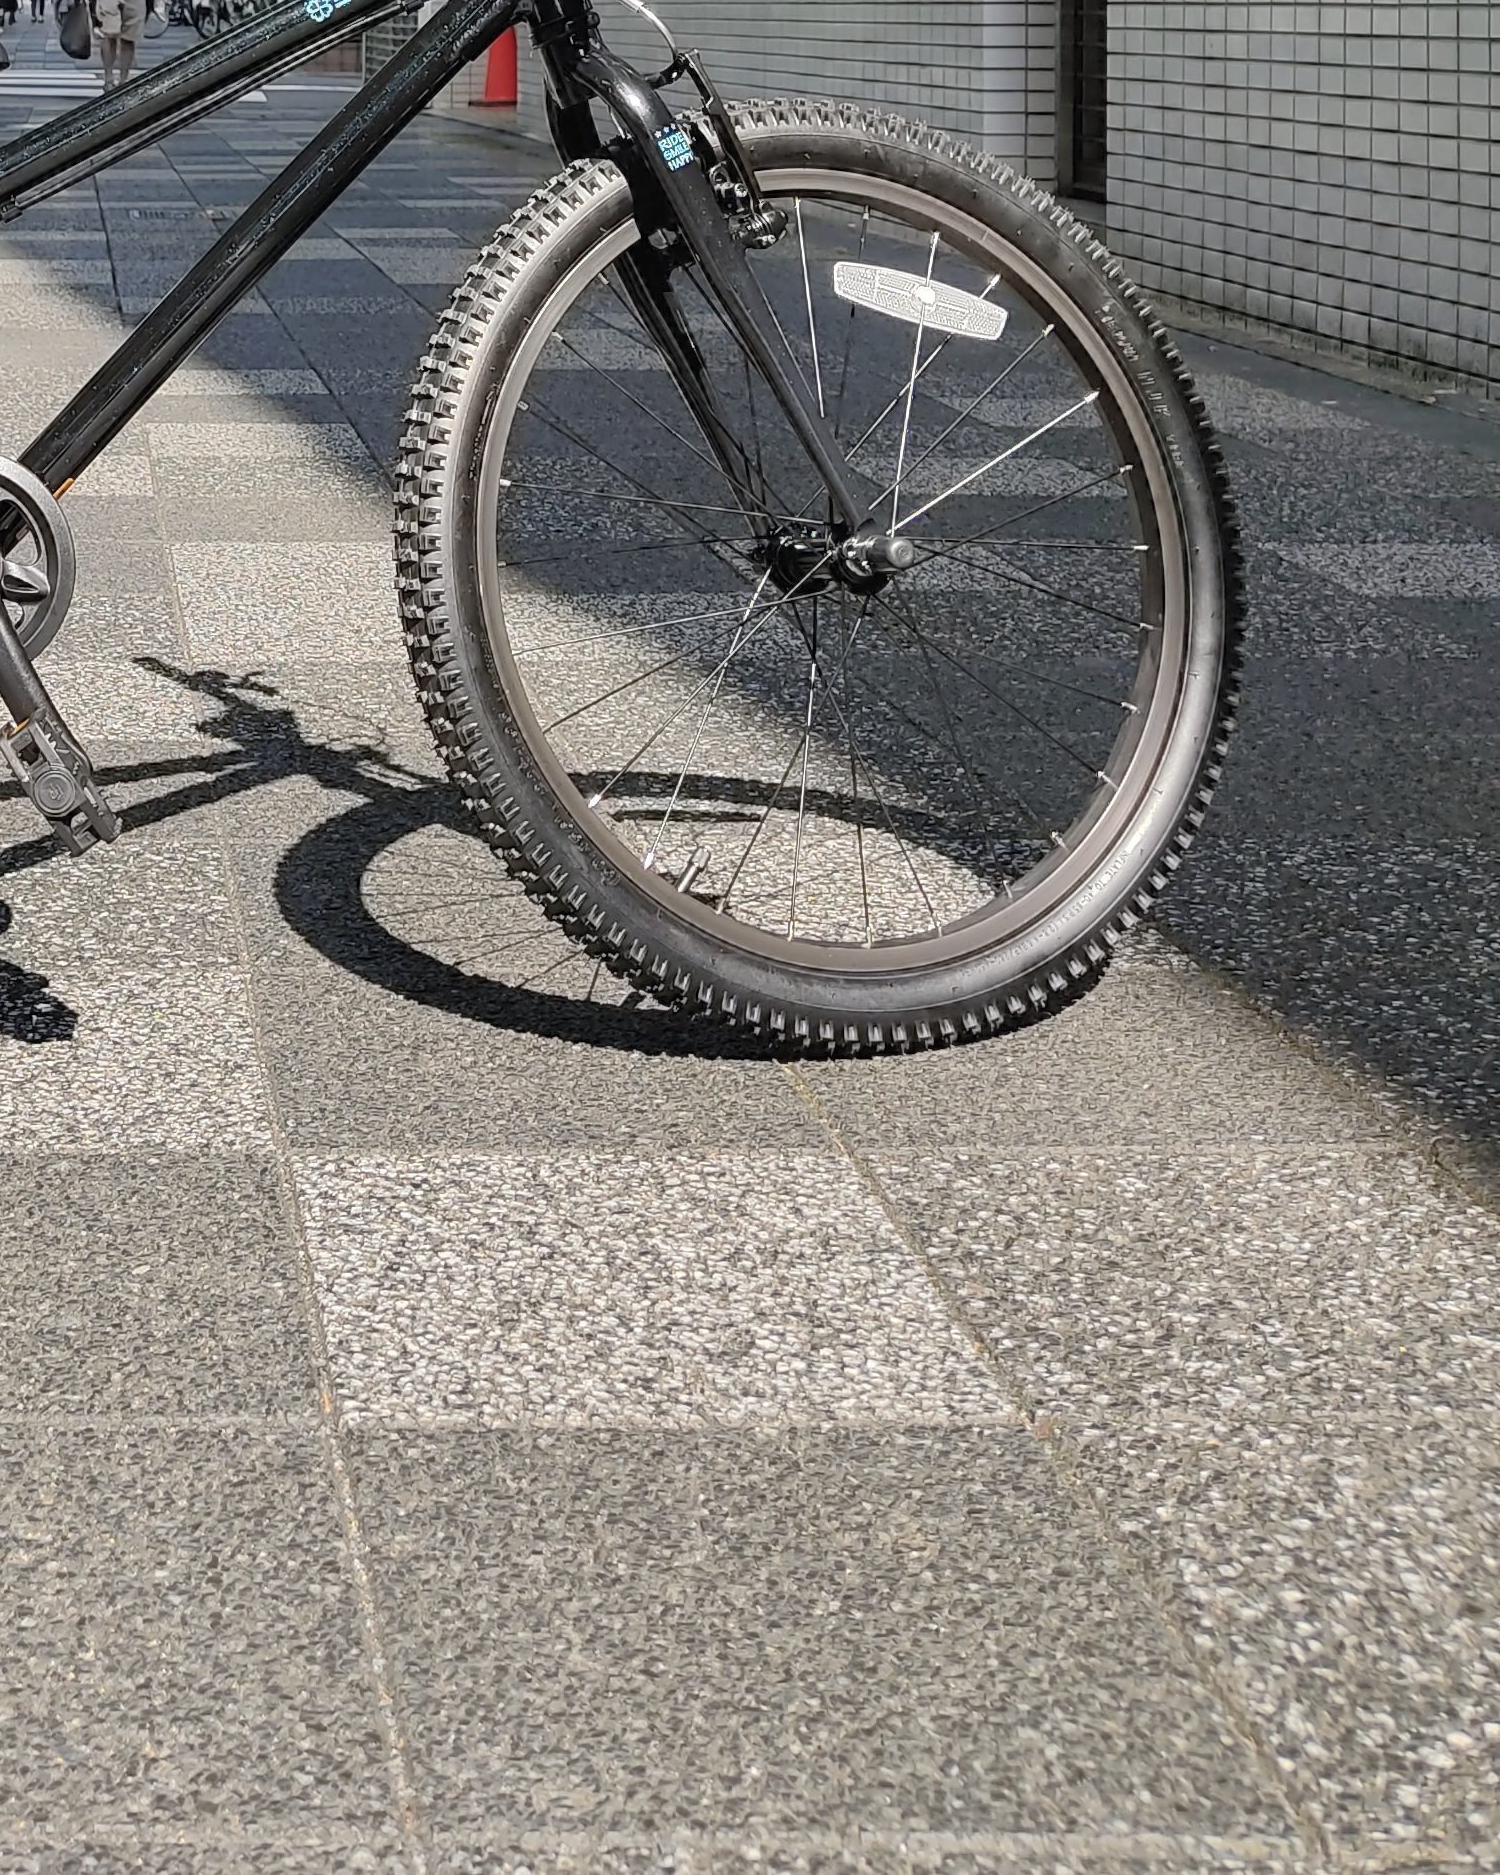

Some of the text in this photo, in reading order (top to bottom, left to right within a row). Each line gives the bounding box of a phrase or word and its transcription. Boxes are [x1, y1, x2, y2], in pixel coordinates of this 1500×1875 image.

[658, 131, 684, 152] RIDE
[663, 141, 690, 161] SMILE
[667, 151, 694, 172] HAPPY
